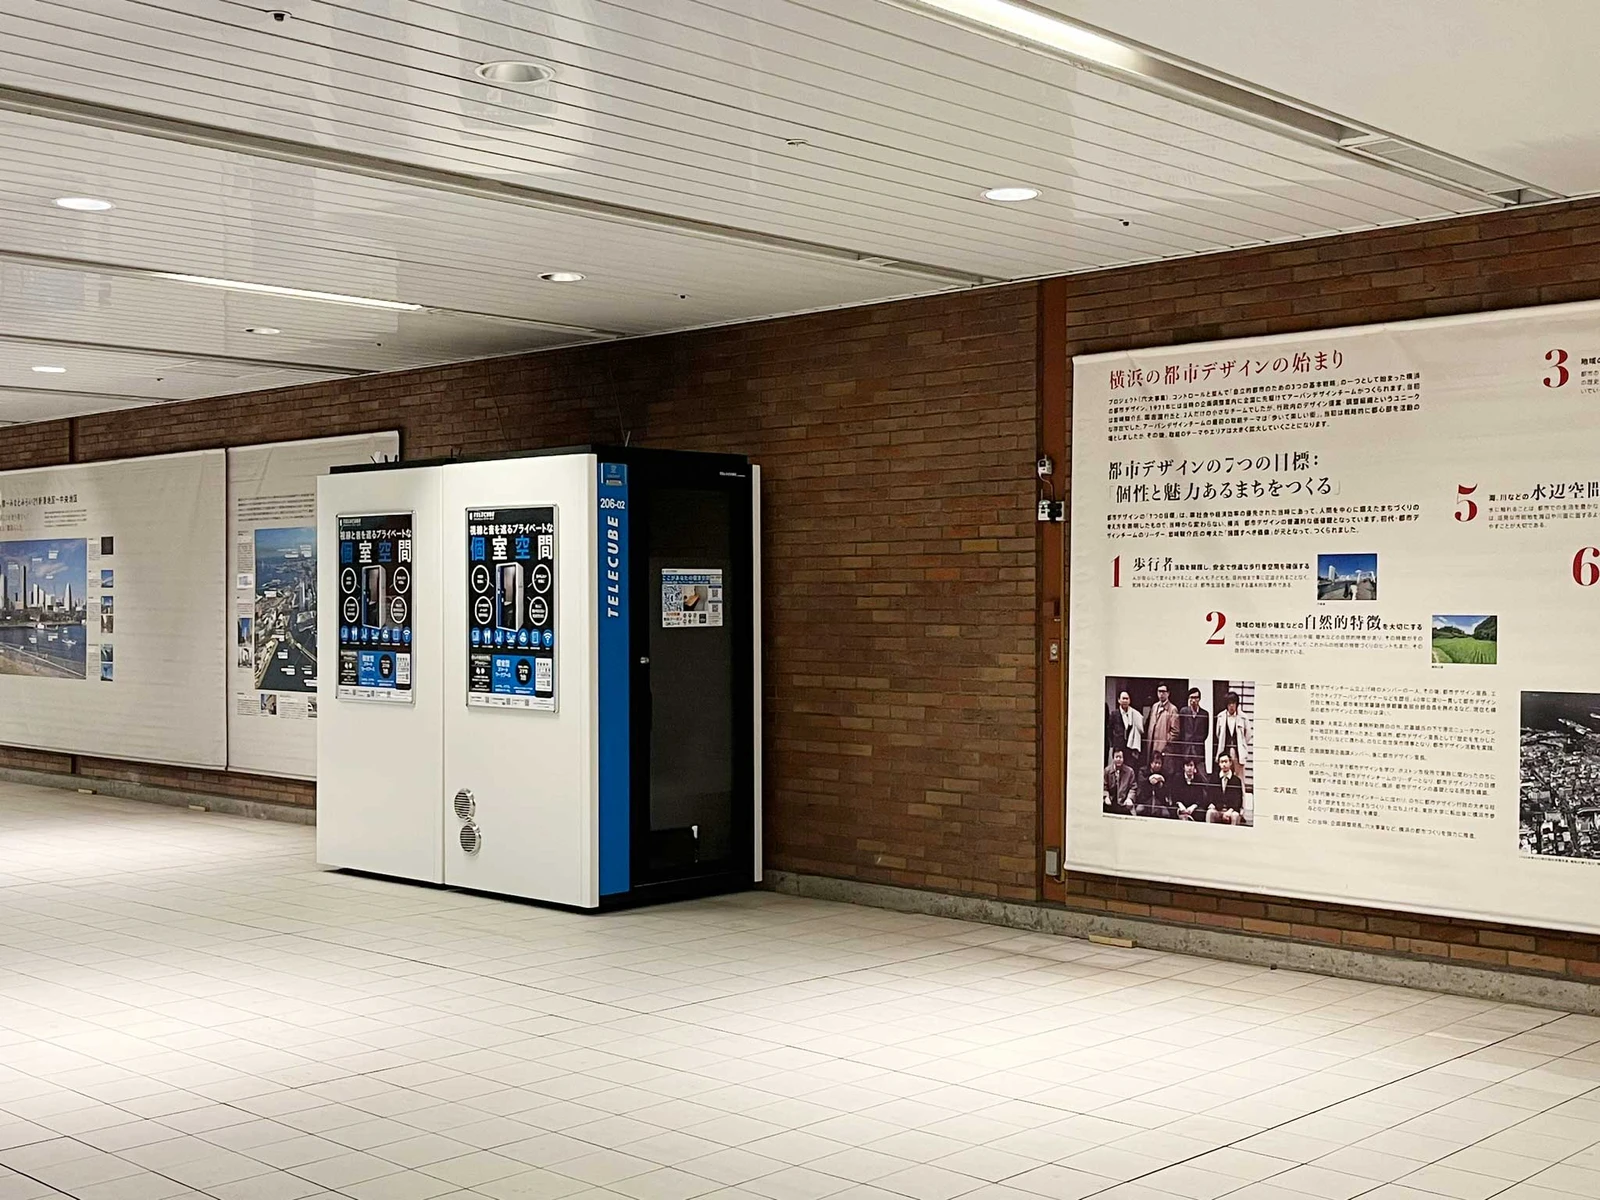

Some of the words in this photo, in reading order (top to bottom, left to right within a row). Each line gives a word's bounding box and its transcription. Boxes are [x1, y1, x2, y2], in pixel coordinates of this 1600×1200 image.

[1109, 349, 1344, 390] 横浜の都市デザインの始まり
[1543, 349, 1569, 389] 3
[600, 498, 625, 509] 206-02
[1107, 475, 1341, 504] 「個性と魅力あるまちをつくる」
[1454, 483, 1478, 522] 5
[341, 539, 412, 564] 個室空間
[470, 534, 553, 561] 個室空間
[607, 515, 619, 618] TELECUBE
[1110, 555, 1123, 588] 1
[1572, 546, 1600, 586] 6
[1206, 611, 1226, 645] 2
